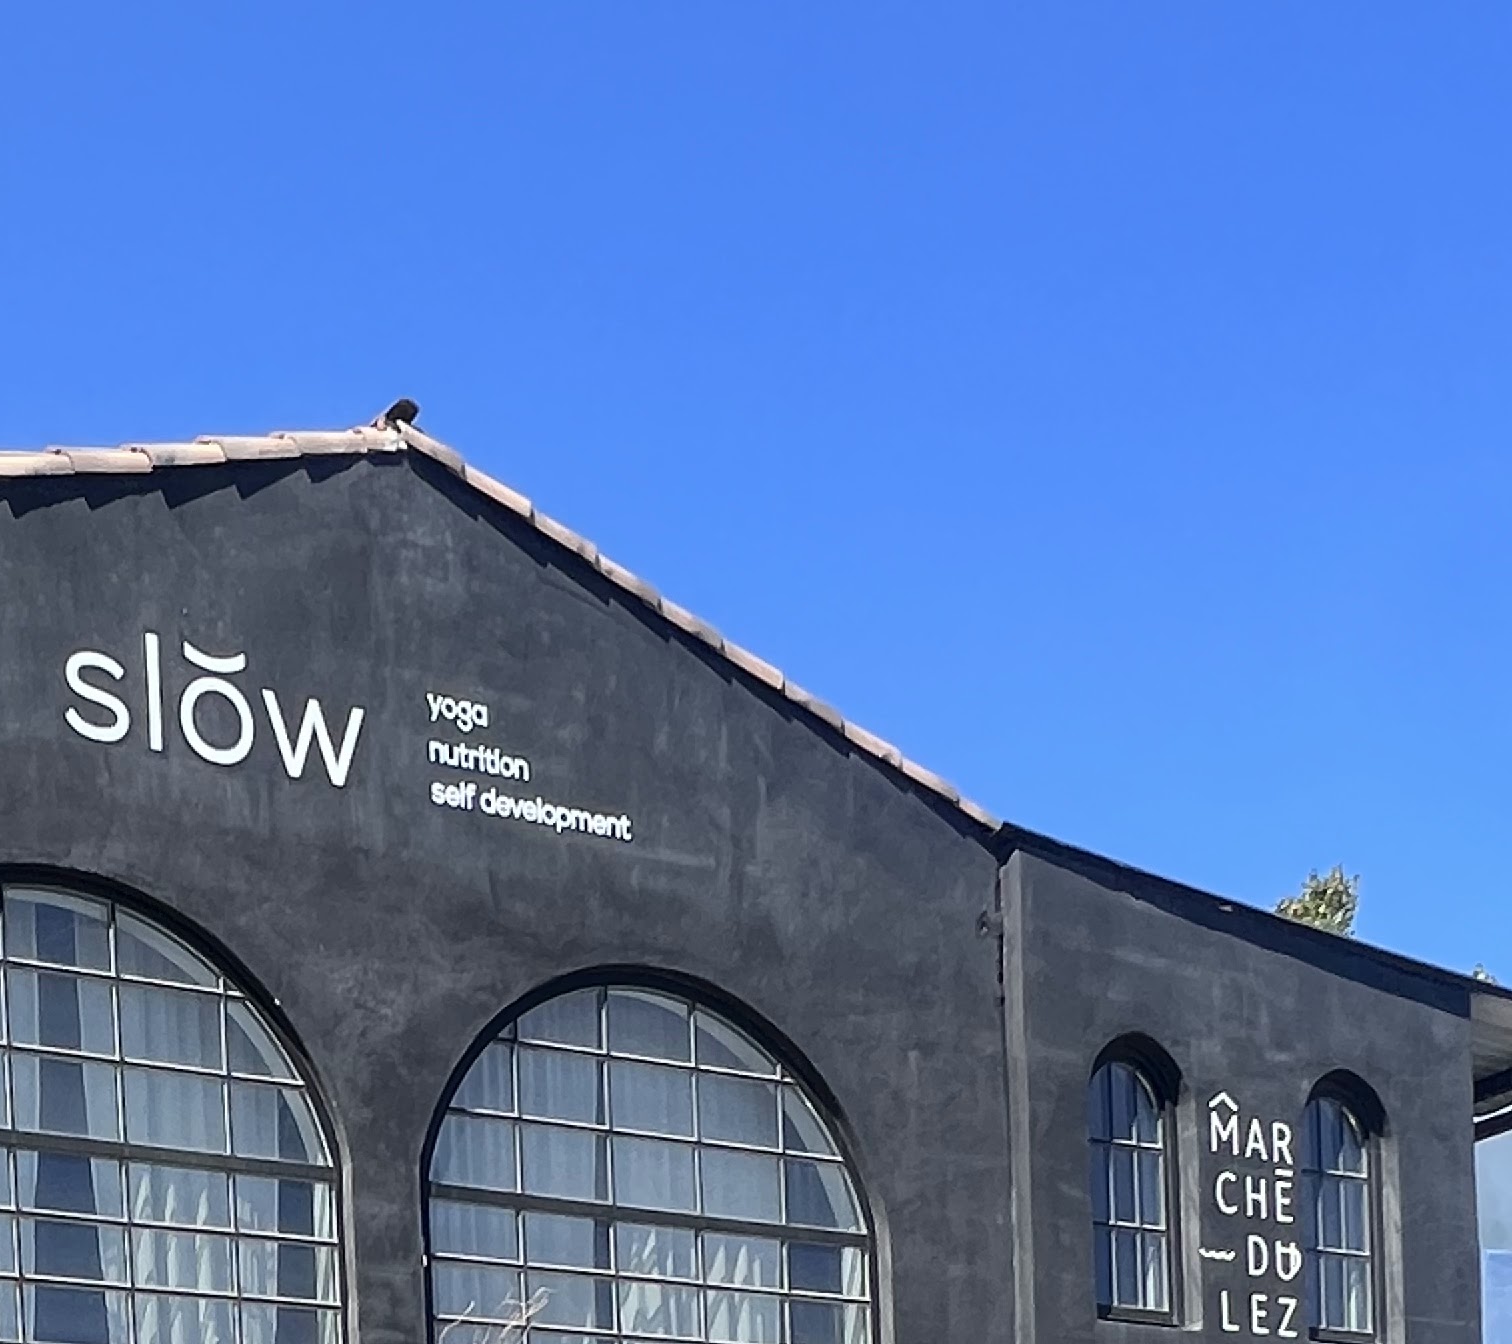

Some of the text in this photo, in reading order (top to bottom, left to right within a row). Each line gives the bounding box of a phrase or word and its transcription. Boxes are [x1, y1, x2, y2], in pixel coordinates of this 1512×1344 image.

[427, 693, 488, 732] yoga
[428, 740, 530, 782] nutrition
[430, 781, 632, 841] self development
[1220, 1290, 1298, 1338] LEZ
